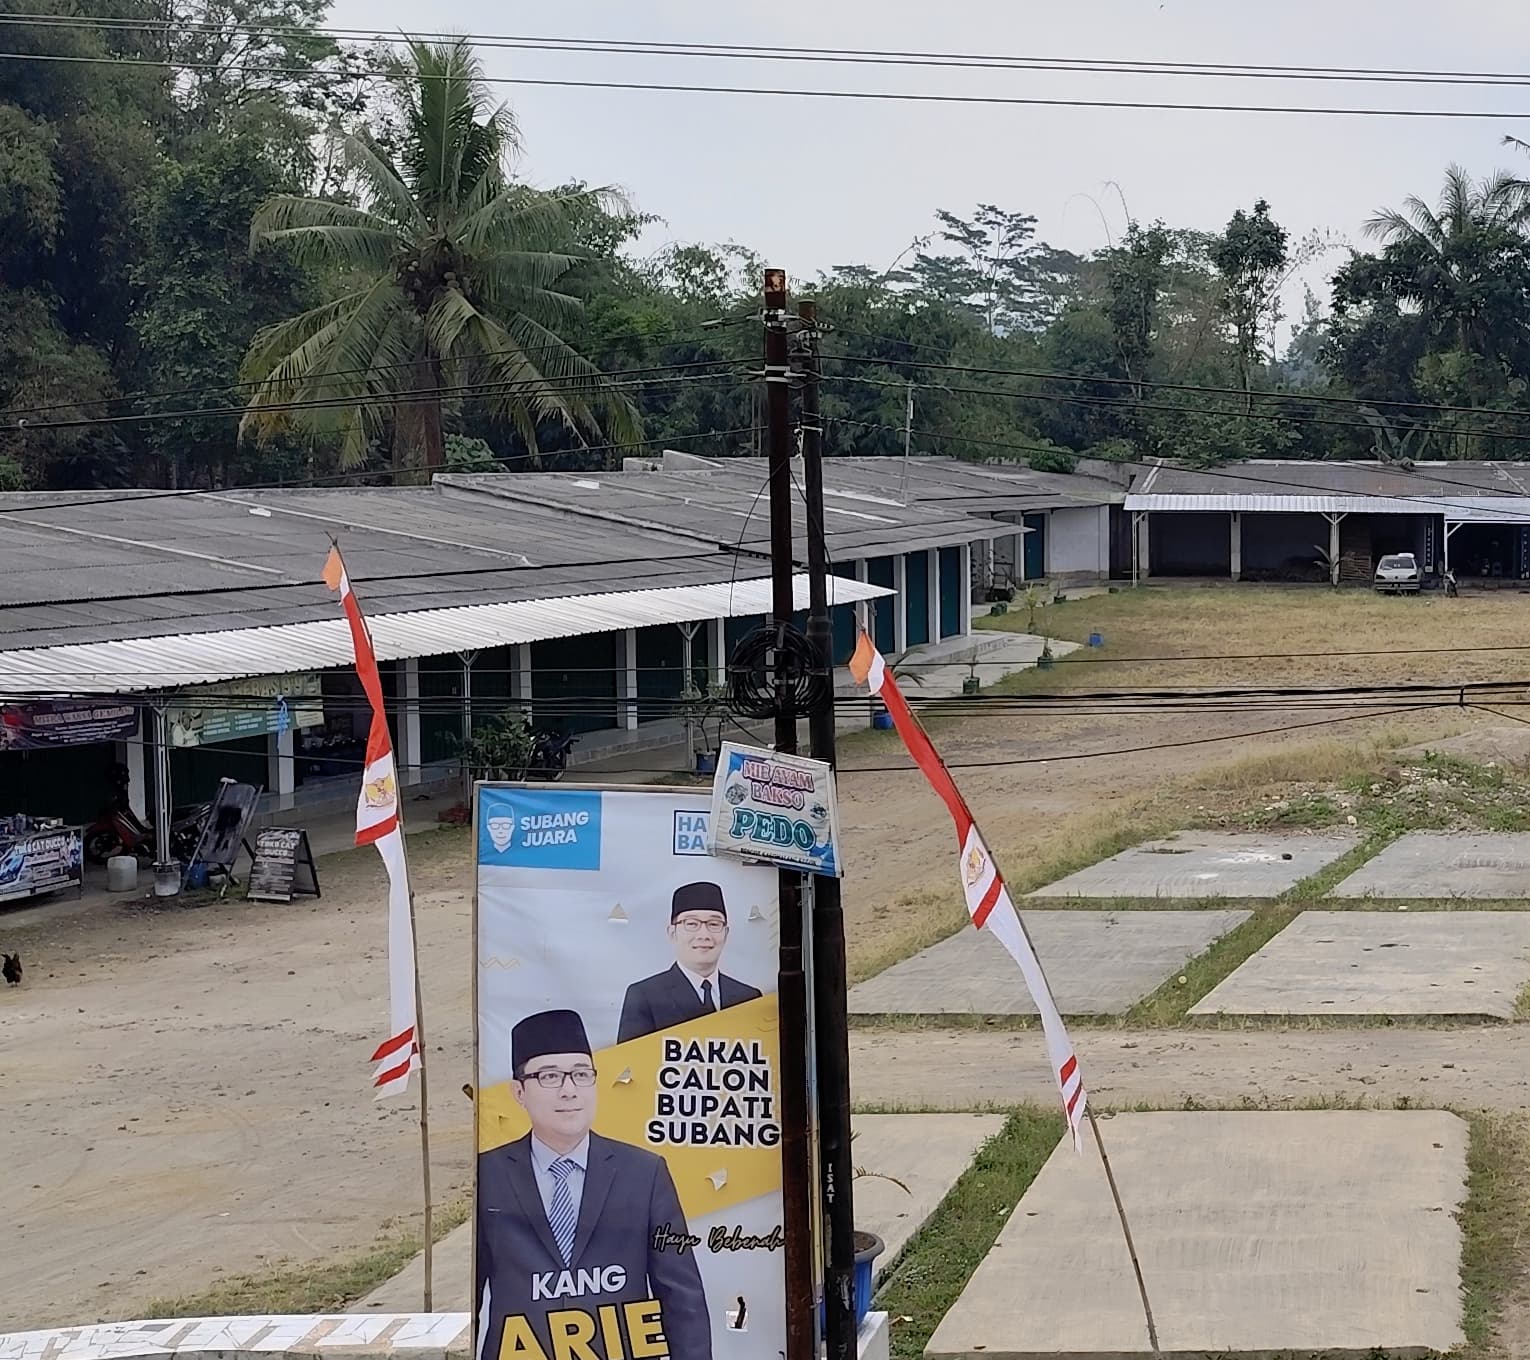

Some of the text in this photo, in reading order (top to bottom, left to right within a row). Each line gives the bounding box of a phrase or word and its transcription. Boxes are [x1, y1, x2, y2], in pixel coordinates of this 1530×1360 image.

[743, 760, 814, 791] MIE AYAM
[752, 781, 804, 809] BAKSO
[520, 811, 589, 831] SUBANG
[731, 808, 816, 850] PEDO
[522, 829, 577, 847] JUARA
[665, 1040, 766, 1064] BAKAL
[660, 1067, 768, 1091] CALON
[658, 1094, 772, 1118] BUPATI
[648, 1121, 780, 1146] SUBANG
[827, 1163, 835, 1203] ISAT
[653, 1224, 701, 1253] Hayu
[532, 1265, 626, 1301] KANG
